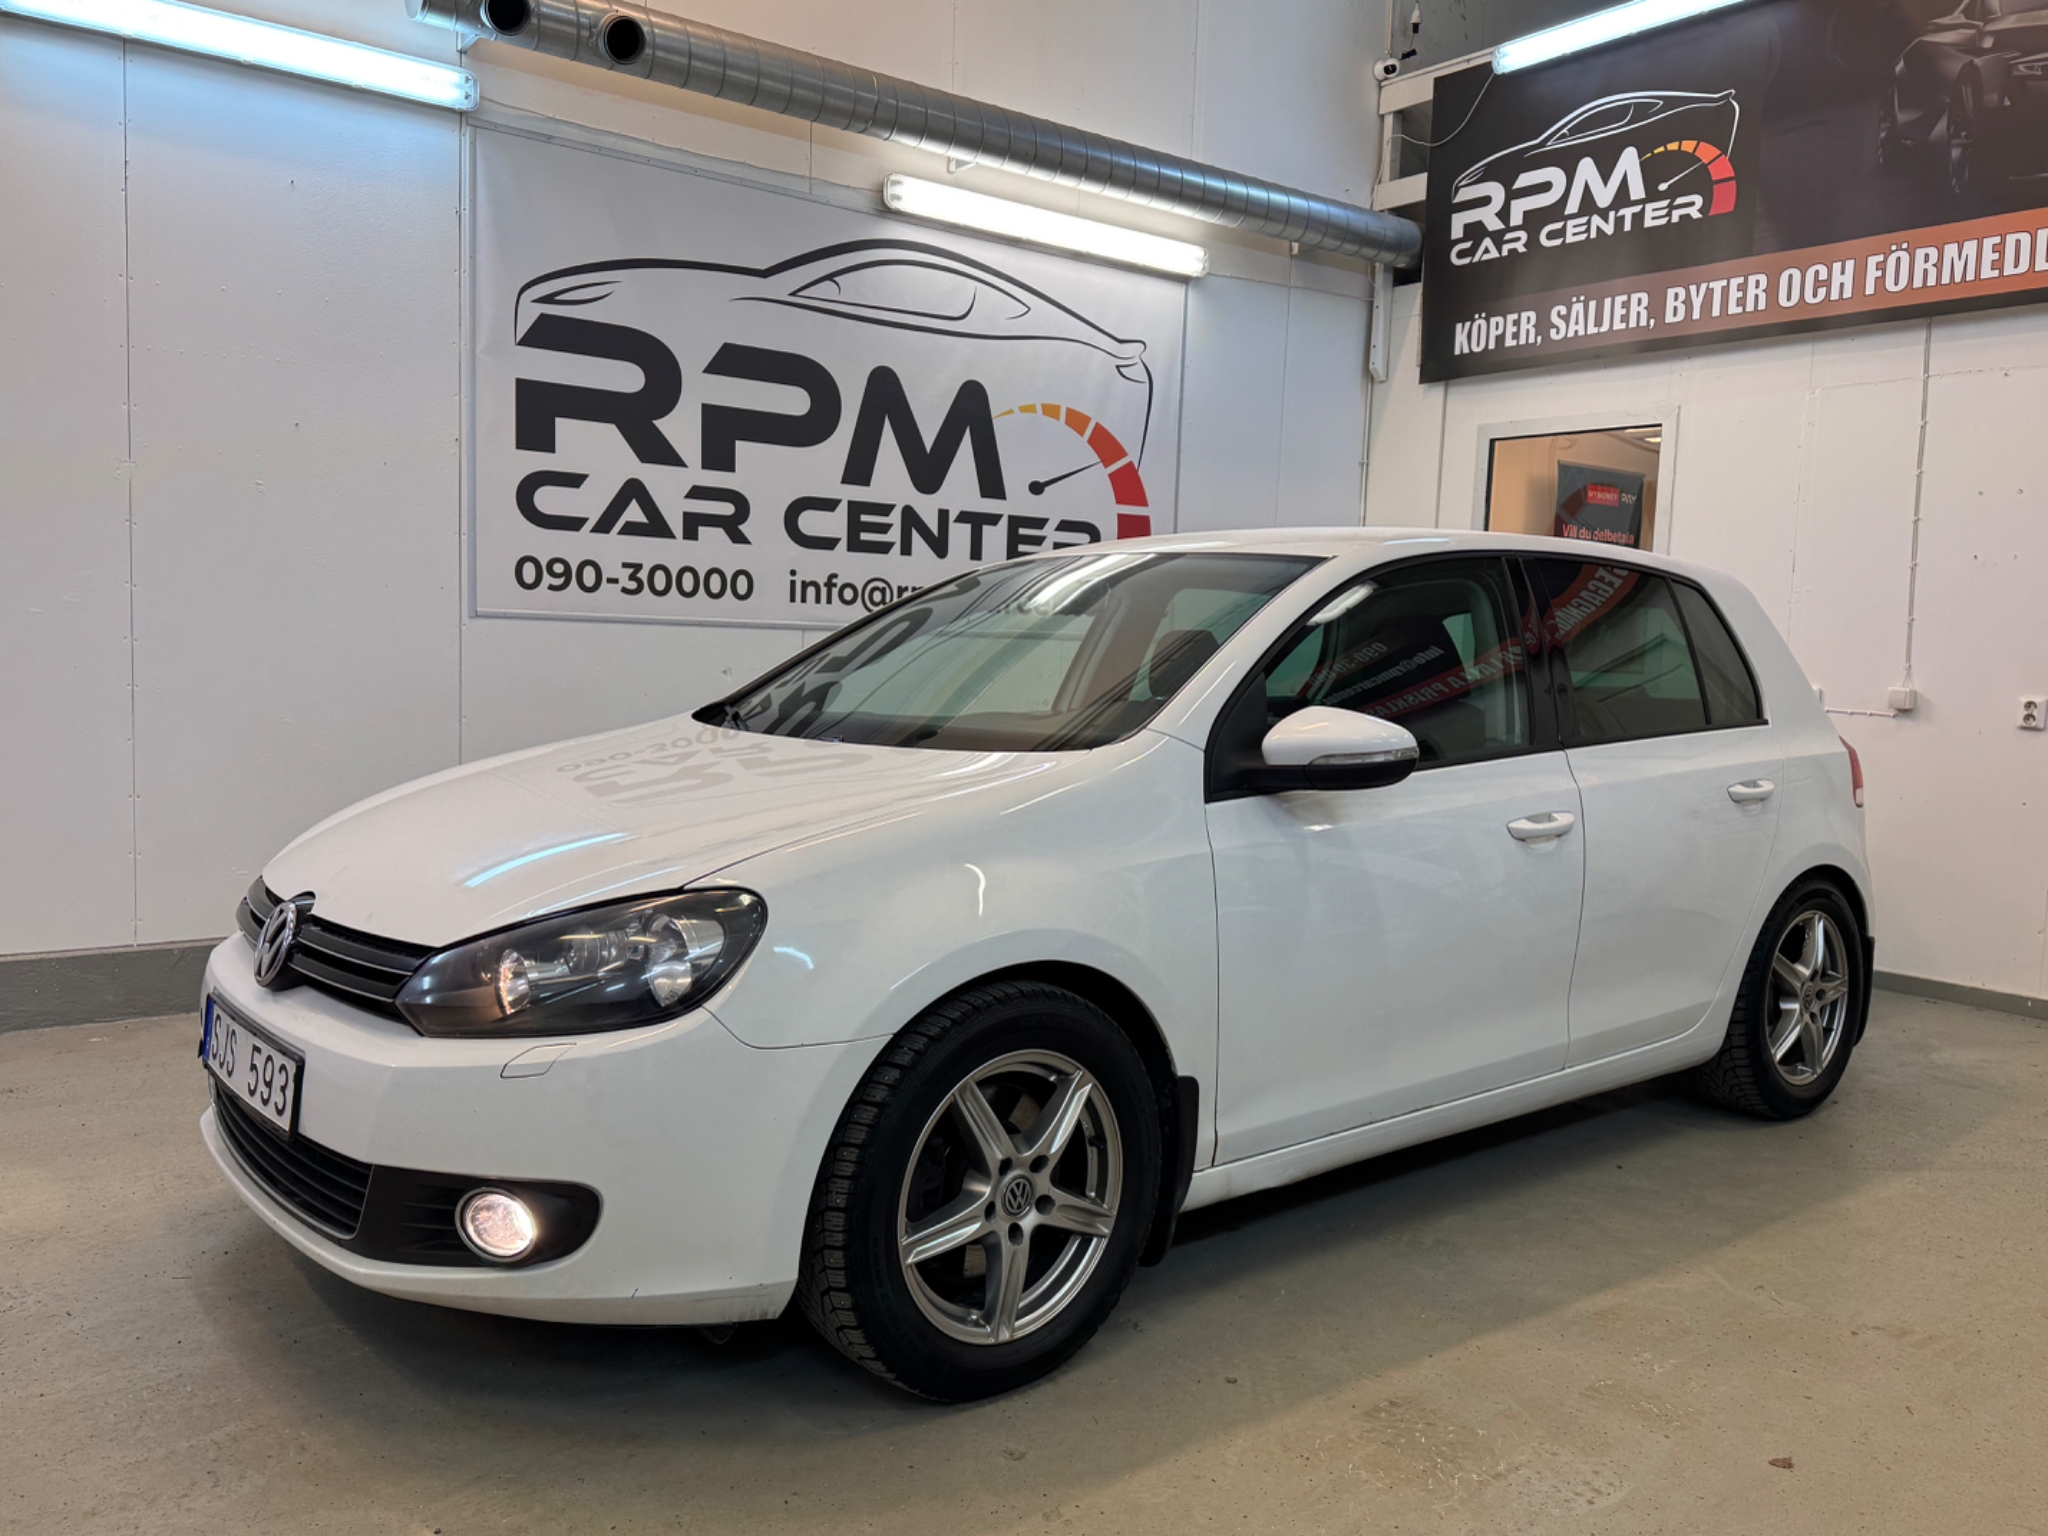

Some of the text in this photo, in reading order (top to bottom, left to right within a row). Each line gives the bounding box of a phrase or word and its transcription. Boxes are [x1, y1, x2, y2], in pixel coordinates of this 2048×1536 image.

[1450, 194, 1703, 266] CAR CENTER
[1451, 146, 1646, 240] RPM
[1453, 307, 1543, 356] KÖPER,
[1549, 288, 1656, 342] SÄLJER,
[1664, 272, 1767, 324] BYTER
[1777, 258, 1856, 309] OCH
[515, 312, 1007, 500] RPM
[515, 469, 752, 545] CAR
[1562, 524, 1577, 539] Vill
[1579, 527, 1591, 539] du
[514, 555, 754, 601] 090-30000
[211, 1013, 289, 1117] SJS 593
